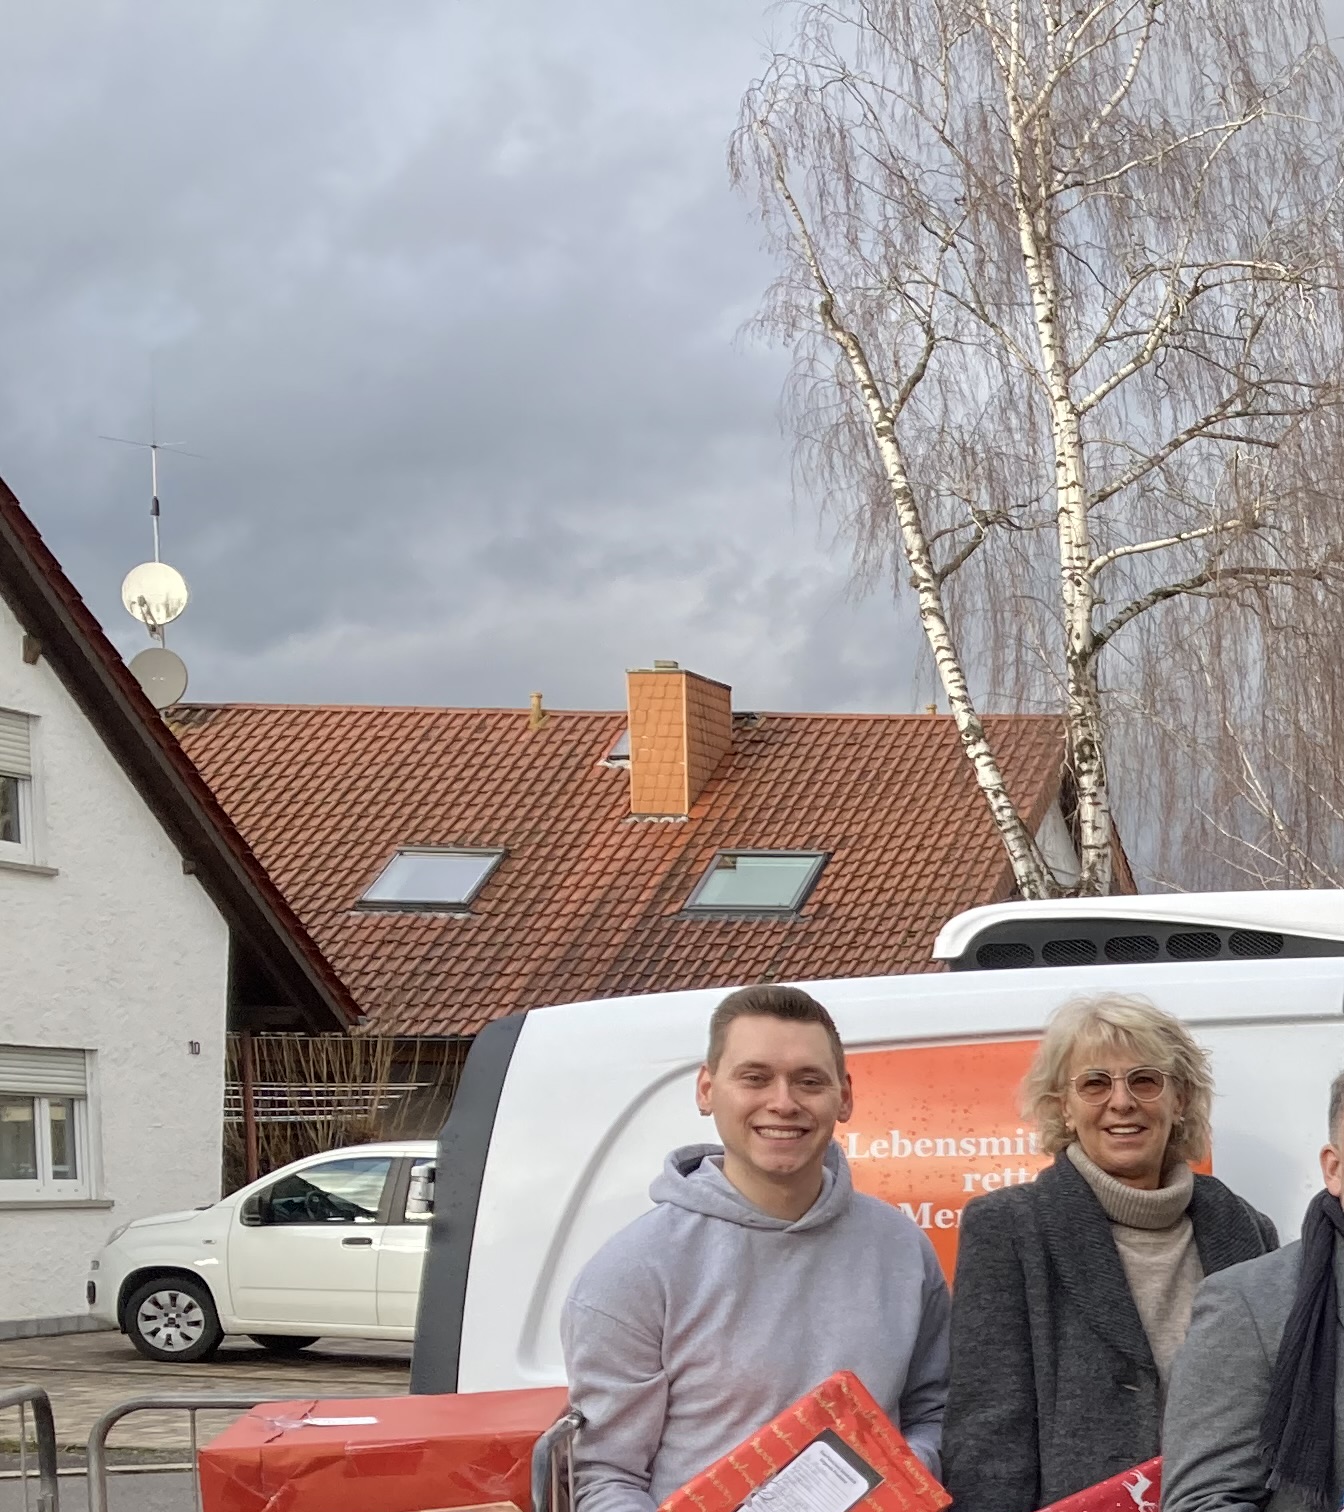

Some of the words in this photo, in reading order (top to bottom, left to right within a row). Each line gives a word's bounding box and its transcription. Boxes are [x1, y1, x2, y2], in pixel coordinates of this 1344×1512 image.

[188, 1040, 200, 1055] 10
[846, 1128, 1041, 1160] Lebensmit
[962, 1167, 1037, 1193] rett
[897, 1202, 962, 1230] Me
